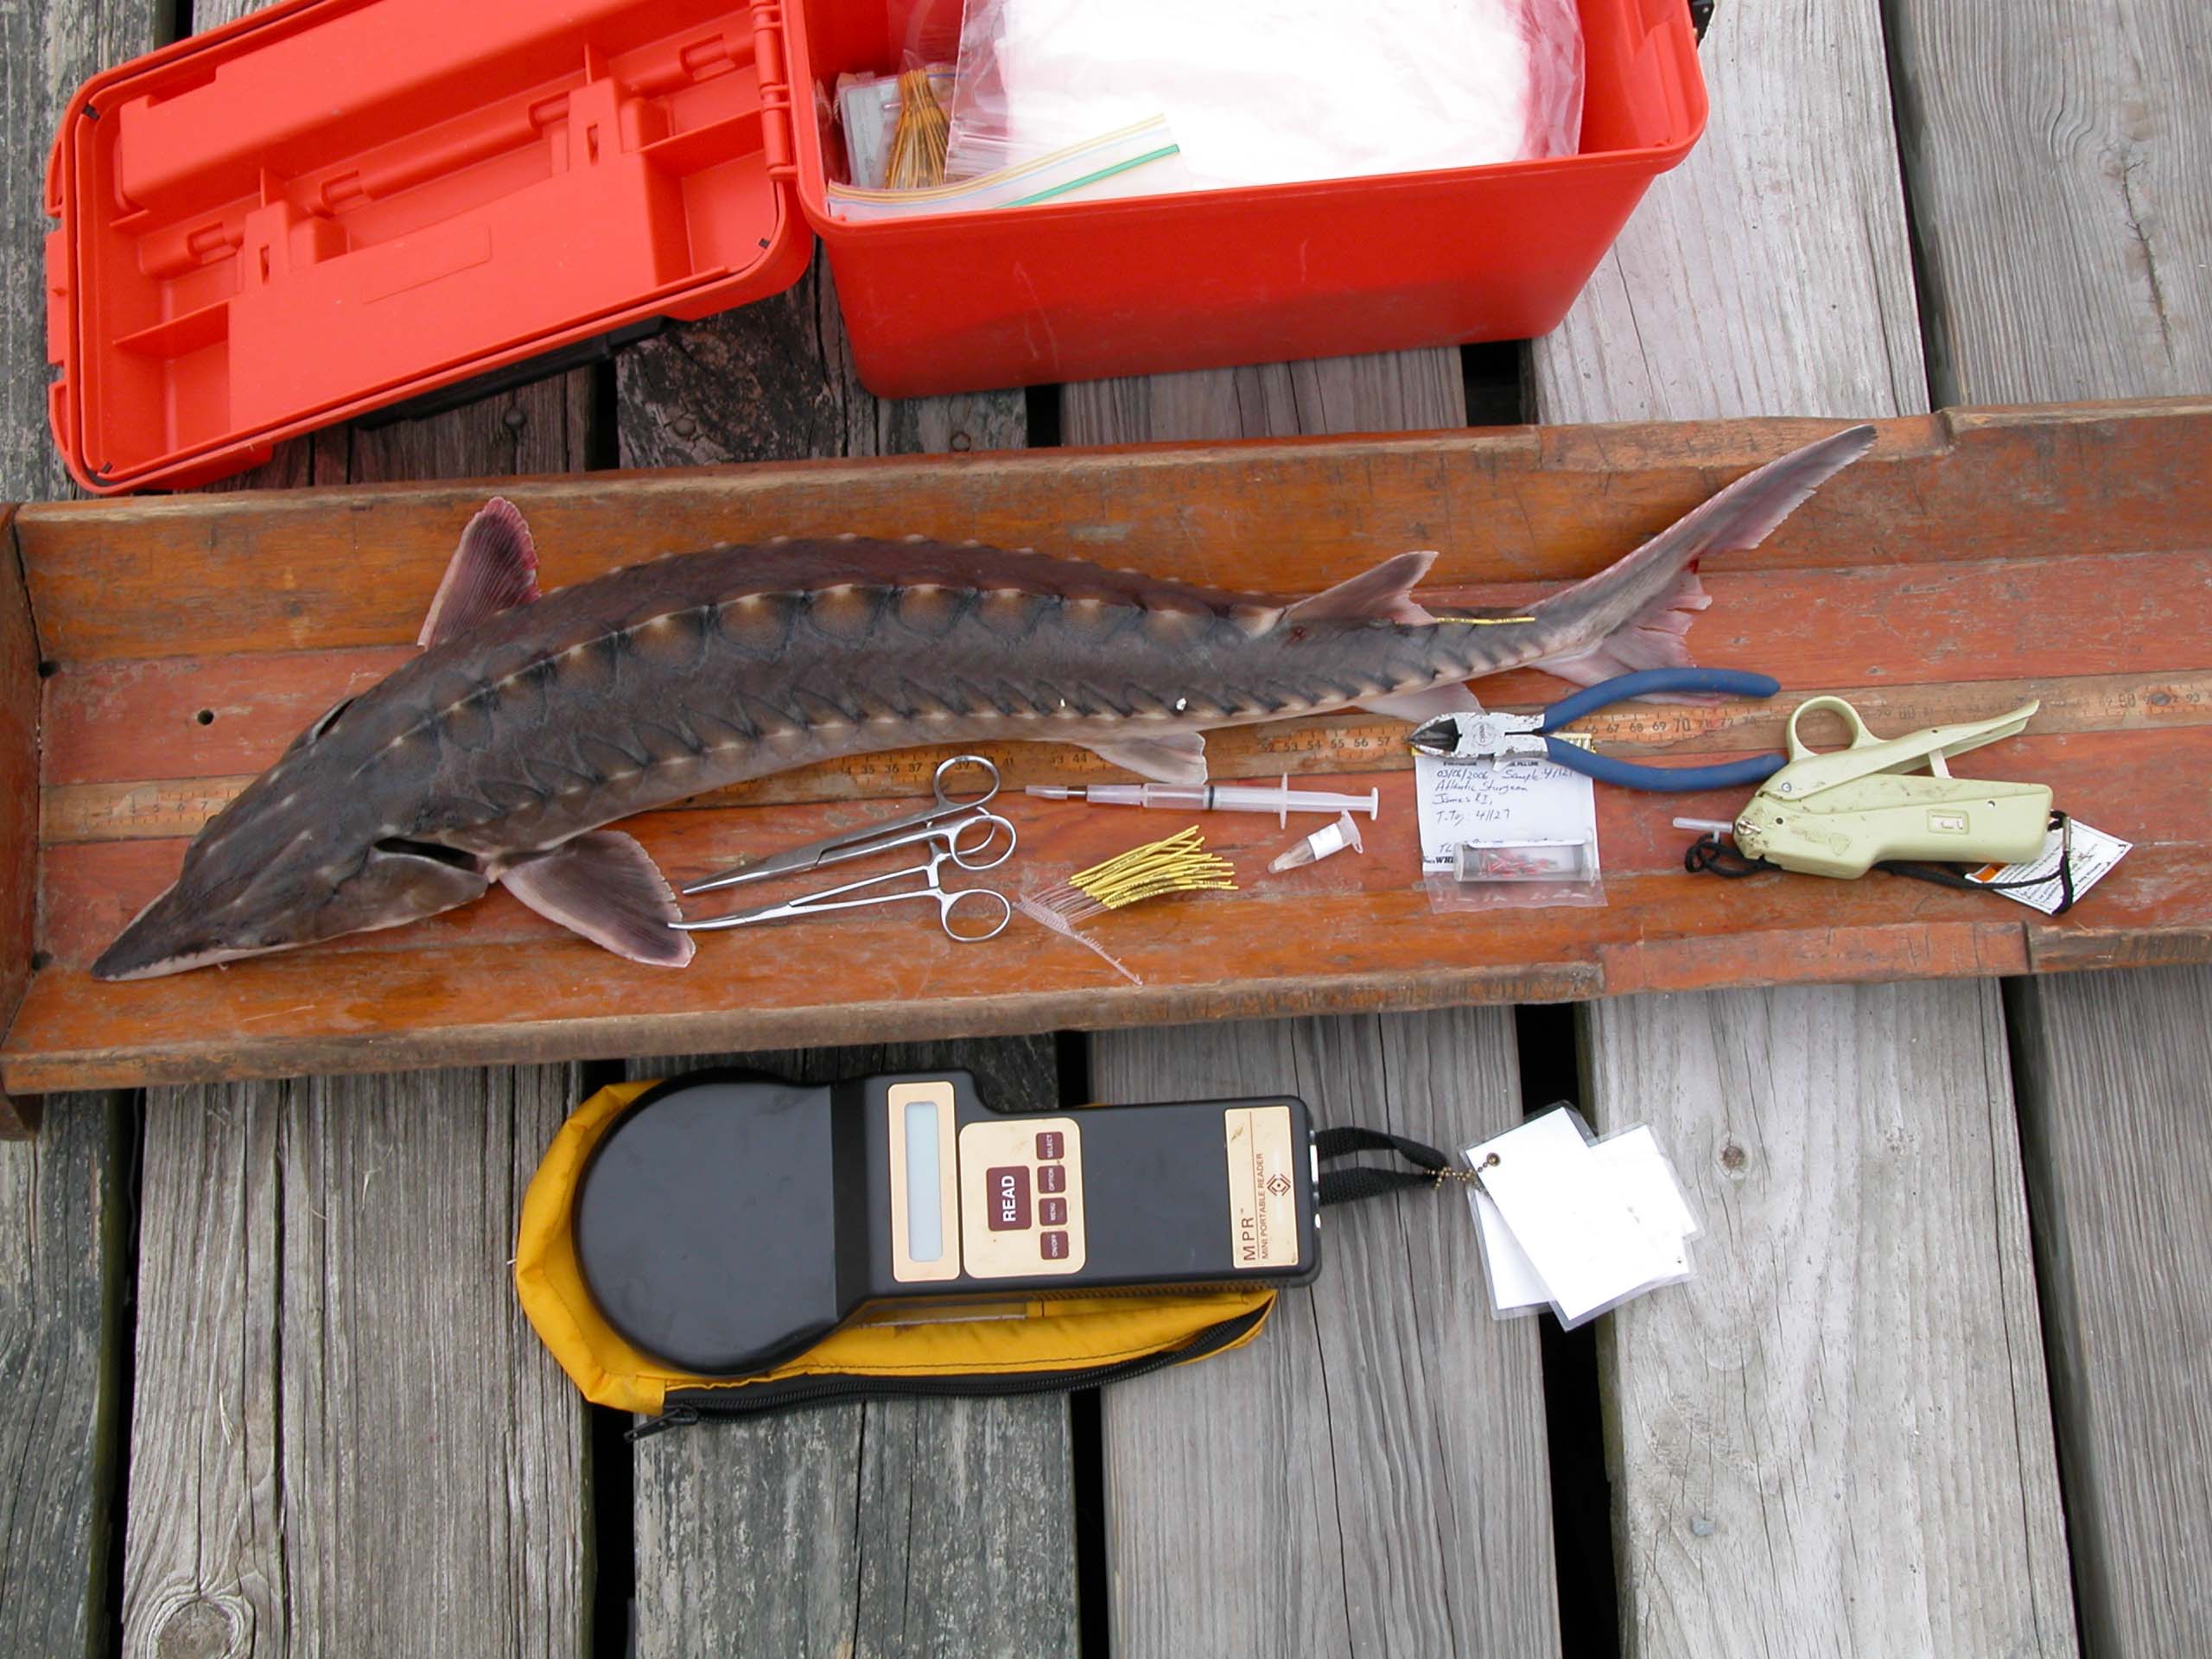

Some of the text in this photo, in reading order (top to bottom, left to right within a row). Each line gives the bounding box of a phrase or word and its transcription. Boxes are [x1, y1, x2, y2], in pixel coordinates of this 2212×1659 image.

[1584, 723, 1598, 734] 66
[1606, 722, 1620, 734] 67
[1630, 722, 1644, 732] 68
[1652, 721, 1667, 732] 69
[1674, 717, 1691, 733] 70
[1284, 741, 1298, 752] 53
[1306, 741, 1321, 750] 54
[1331, 739, 1344, 749] 55
[1354, 738, 1369, 747] 56
[1377, 737, 1390, 747] 57
[884, 763, 899, 774] 36
[908, 761, 923, 773] 37
[1072, 753, 1088, 765] 44
[201, 800, 209, 810] 7
[1046, 1133, 1054, 1159] SELECT
[1255, 1154, 1265, 1191] READER
[1001, 1174, 1017, 1222] READ
[1258, 1192, 1268, 1237] PORTABLE
[1241, 1217, 1256, 1262] MPR
